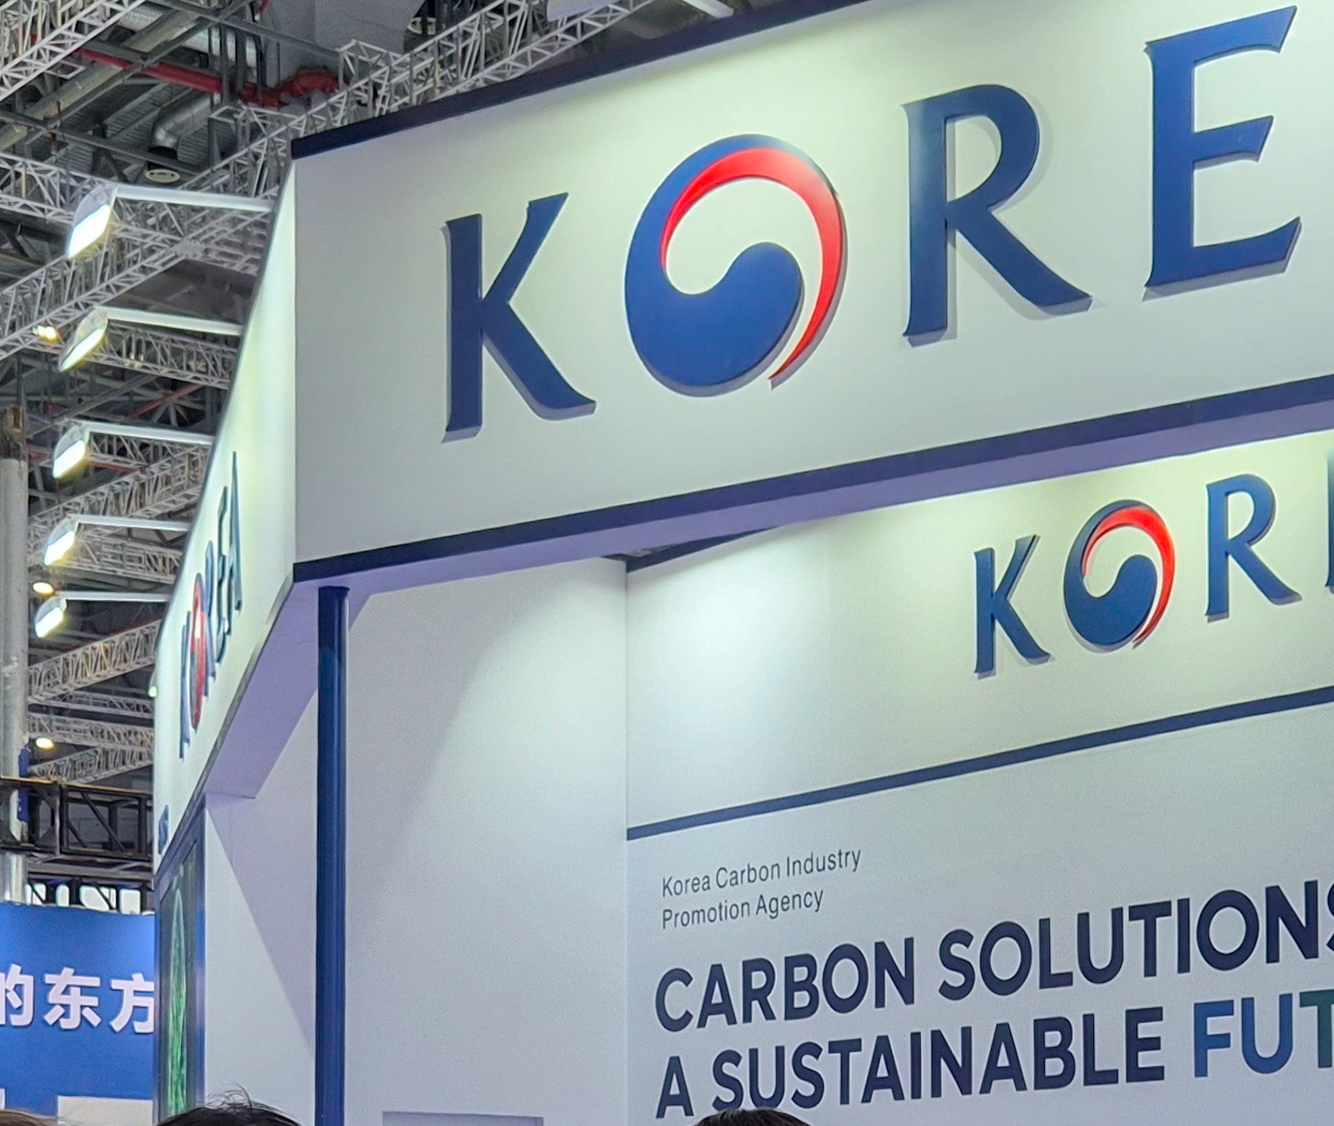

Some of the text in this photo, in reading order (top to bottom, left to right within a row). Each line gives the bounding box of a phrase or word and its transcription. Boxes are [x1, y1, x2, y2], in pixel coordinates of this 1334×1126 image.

[662, 848, 862, 898] Korea Carbon Industry
[662, 889, 824, 930] Promotion Agency
[655, 936, 916, 1033] CARBON
[655, 1054, 696, 1120] A
[712, 1004, 1165, 1112] SUSTAINABLE
